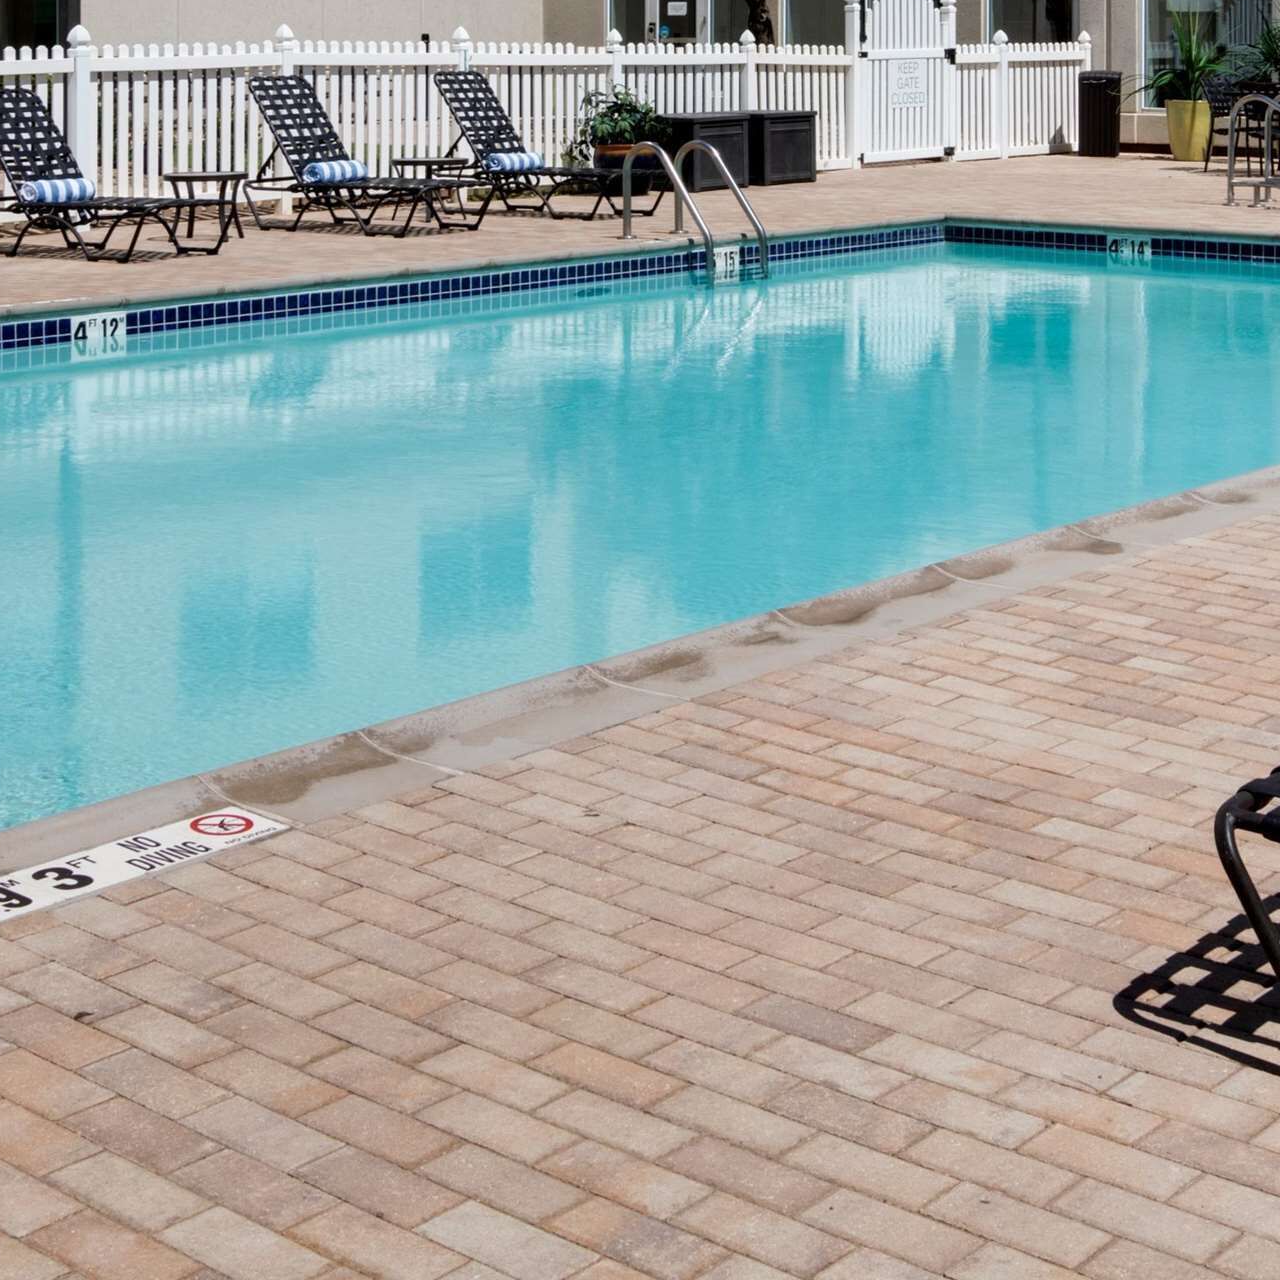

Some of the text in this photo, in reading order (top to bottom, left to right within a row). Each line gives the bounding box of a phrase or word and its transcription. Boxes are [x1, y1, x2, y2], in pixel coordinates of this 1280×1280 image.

[897, 61, 919, 74] KEEP
[896, 76, 920, 90] GATE
[891, 91, 925, 106] CLOSED
[73, 320, 88, 340] 4
[88, 318, 98, 327] FT
[117, 836, 162, 853] NO
[125, 841, 213, 871] DIVING
[0, 878, 21, 889] M
[32, 867, 94, 891] 3
[65, 855, 97, 869] FT
